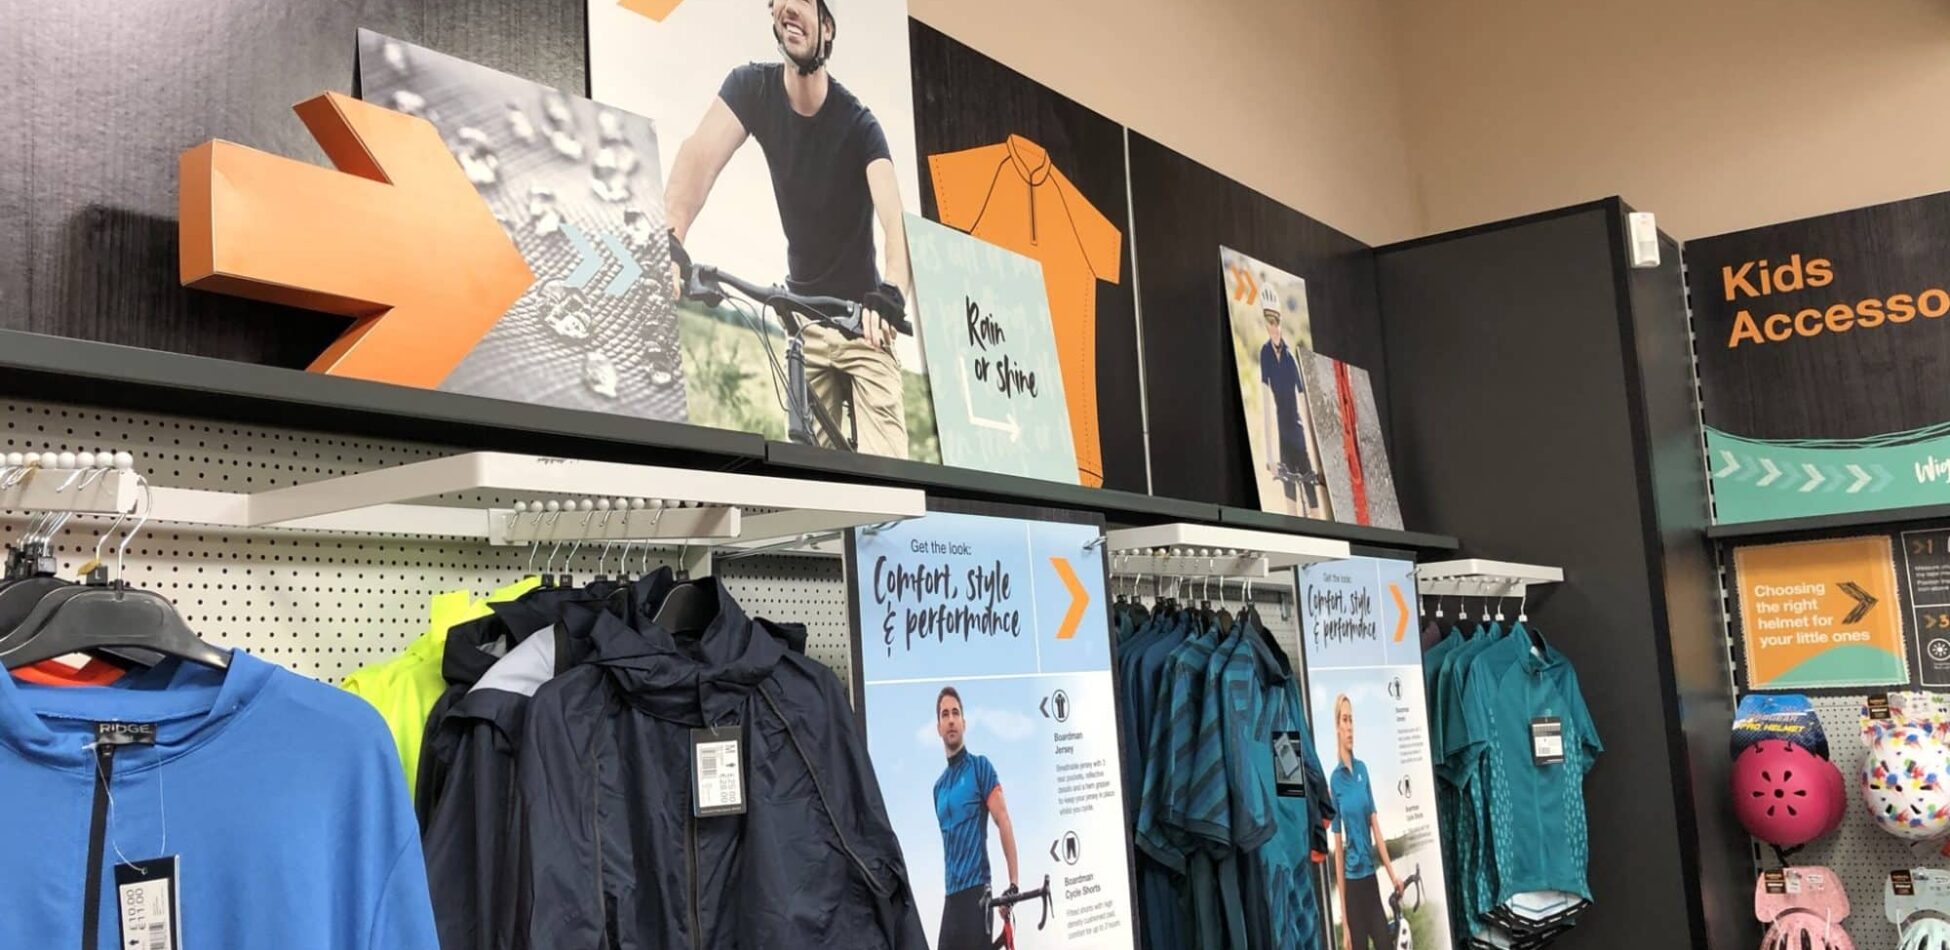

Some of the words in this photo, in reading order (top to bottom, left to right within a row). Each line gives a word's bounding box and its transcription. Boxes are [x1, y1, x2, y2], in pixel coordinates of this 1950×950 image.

[1722, 254, 1834, 301] Kids
[965, 294, 1006, 351] Rain
[1728, 288, 1950, 348] Accesso
[974, 356, 990, 383] or
[996, 353, 1039, 399] shine
[910, 539, 929, 553] Get
[931, 541, 947, 555] the
[949, 542, 972, 556] look:
[874, 555, 958, 605] Comfort,
[966, 560, 1011, 609] style
[1754, 582, 1825, 597] Choosing
[1308, 583, 1346, 617] Comfort,
[1350, 586, 1371, 620] style
[1756, 601, 1779, 613] the
[1783, 599, 1818, 614] right
[883, 600, 896, 658] &
[905, 604, 1021, 651] performance
[1323, 617, 1376, 648] performance
[1758, 616, 1809, 630] helmet
[1812, 615, 1834, 626] for
[1760, 635, 1793, 649] your
[1796, 631, 1828, 644] little
[1832, 631, 1871, 642] ones
[100, 723, 153, 734] RIDGE
[1055, 746, 1074, 754] Jersey
[1065, 890, 1081, 900] Cycle
[1082, 885, 1101, 895] Shorts
